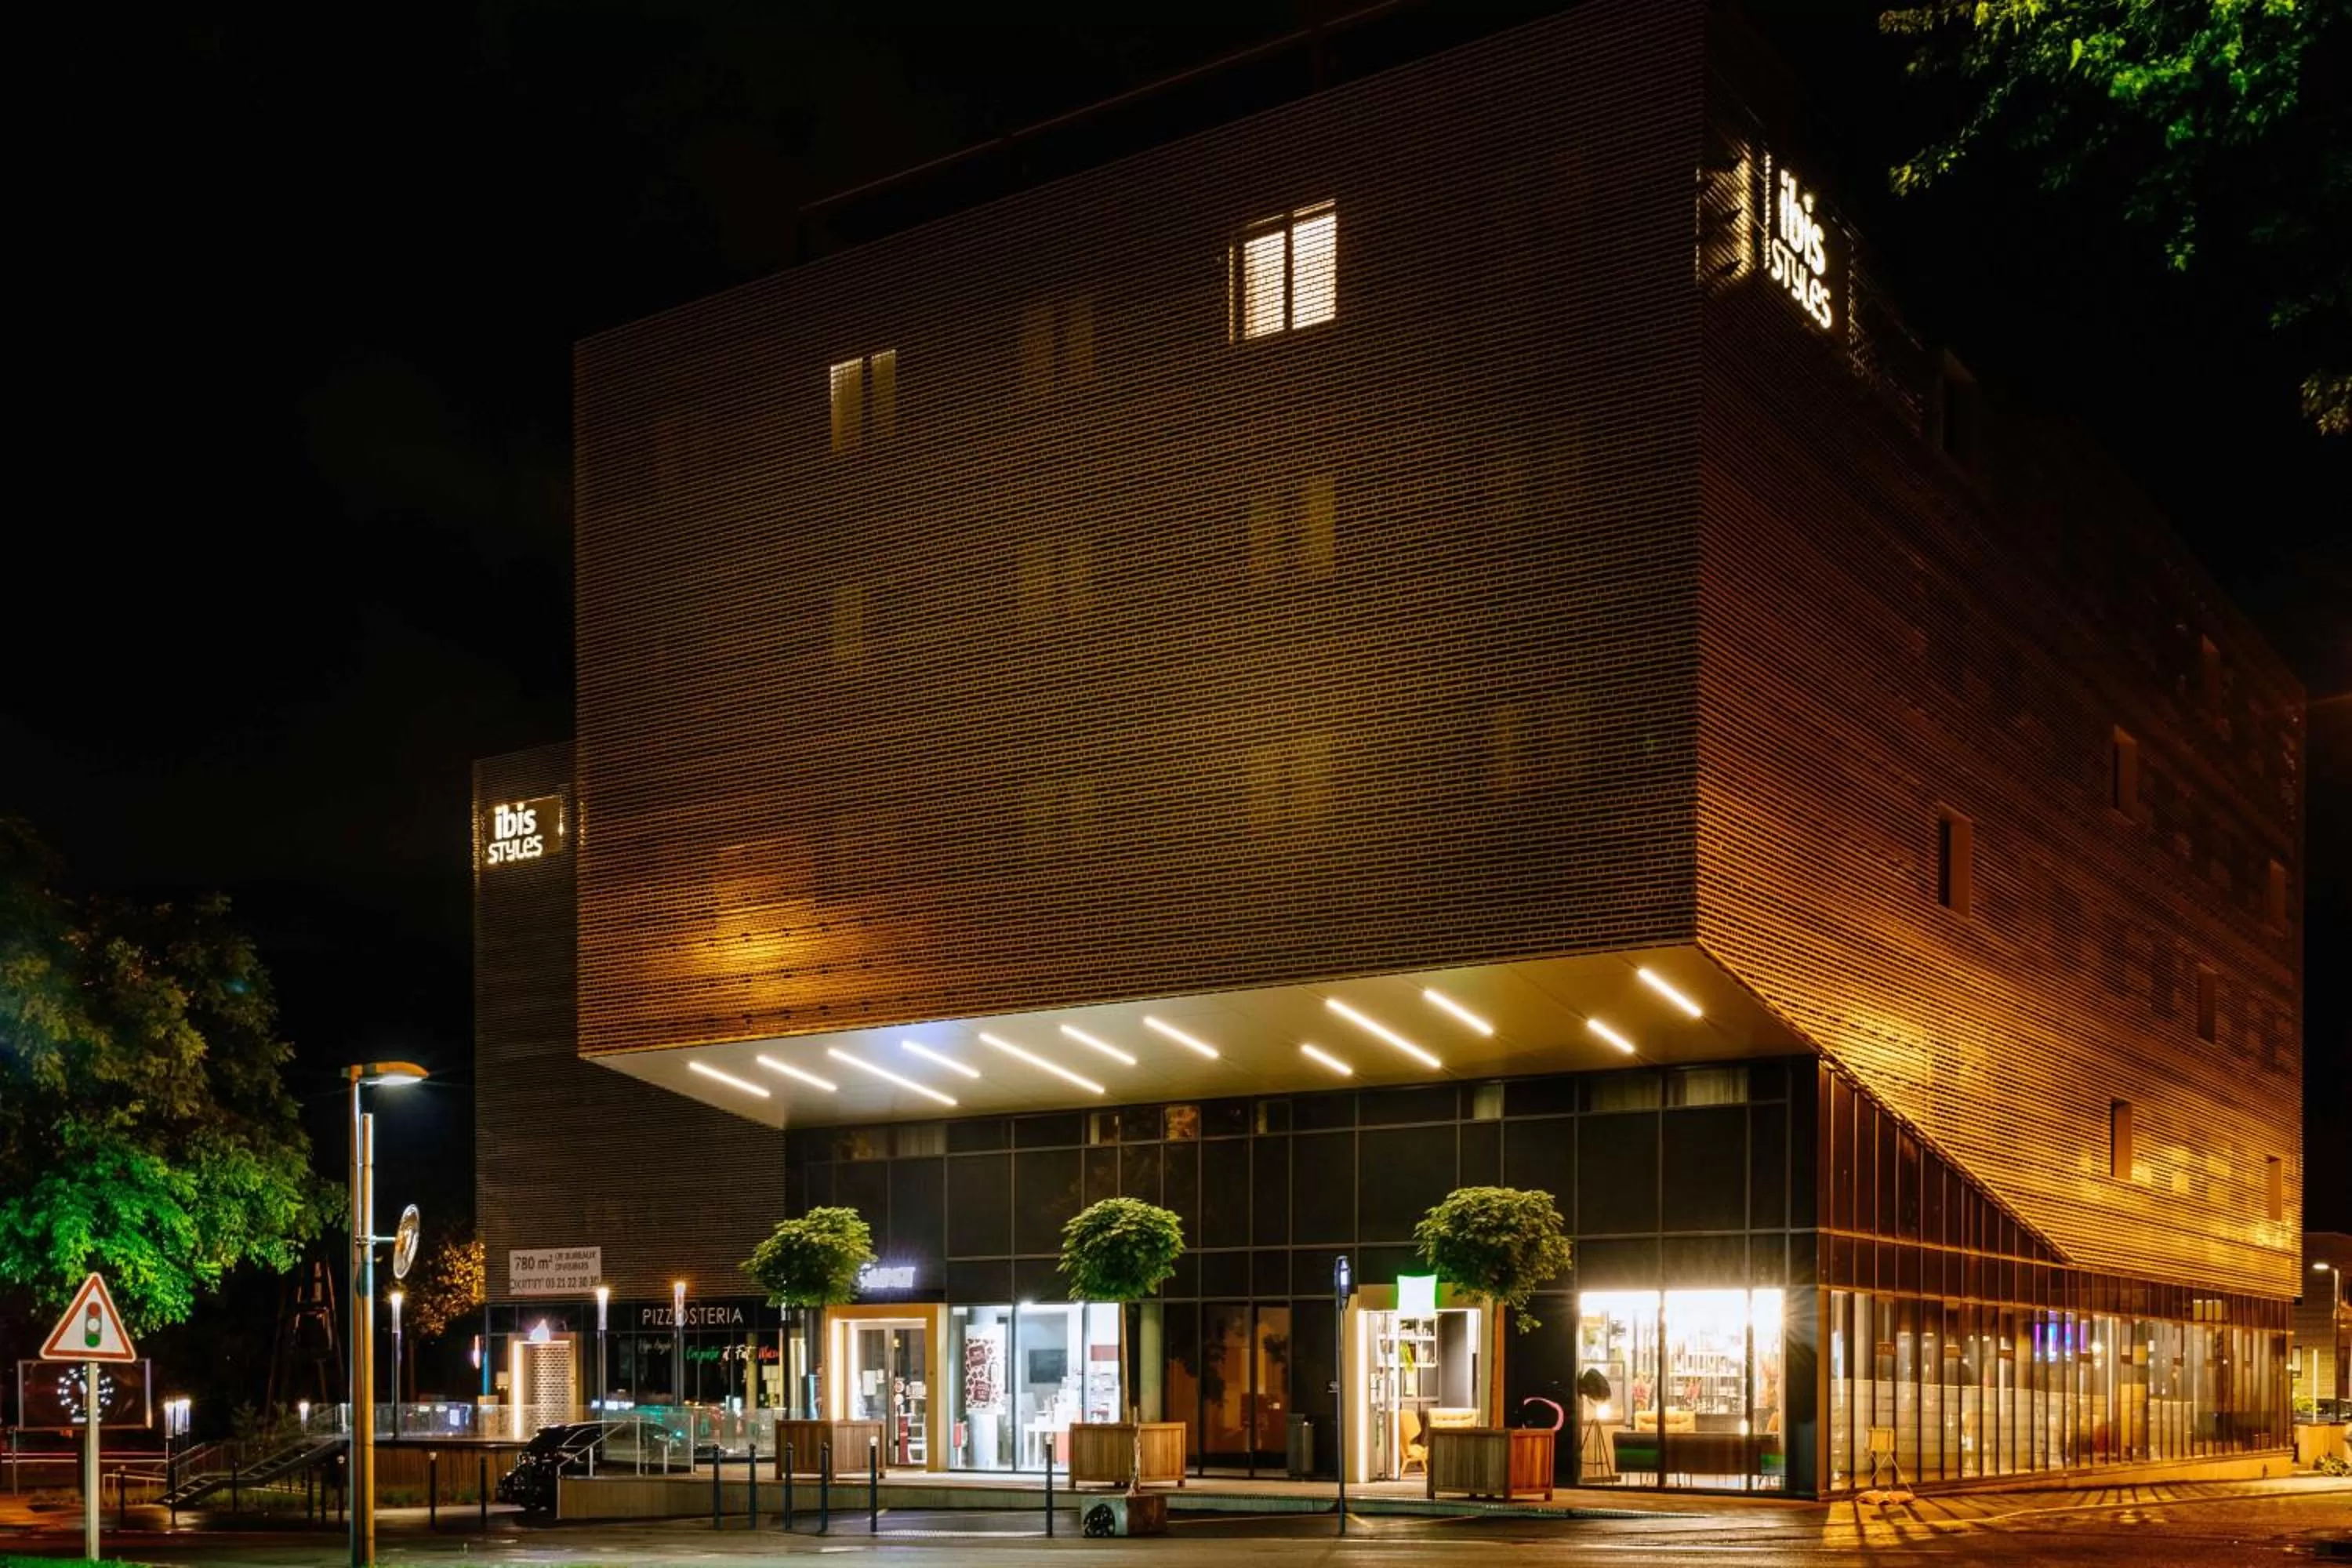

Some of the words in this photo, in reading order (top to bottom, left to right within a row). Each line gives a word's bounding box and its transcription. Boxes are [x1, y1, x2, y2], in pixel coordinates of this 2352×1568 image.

[1780, 169, 1825, 275] ibis
[495, 803, 537, 840] ibis
[514, 1256, 535, 1271] 780
